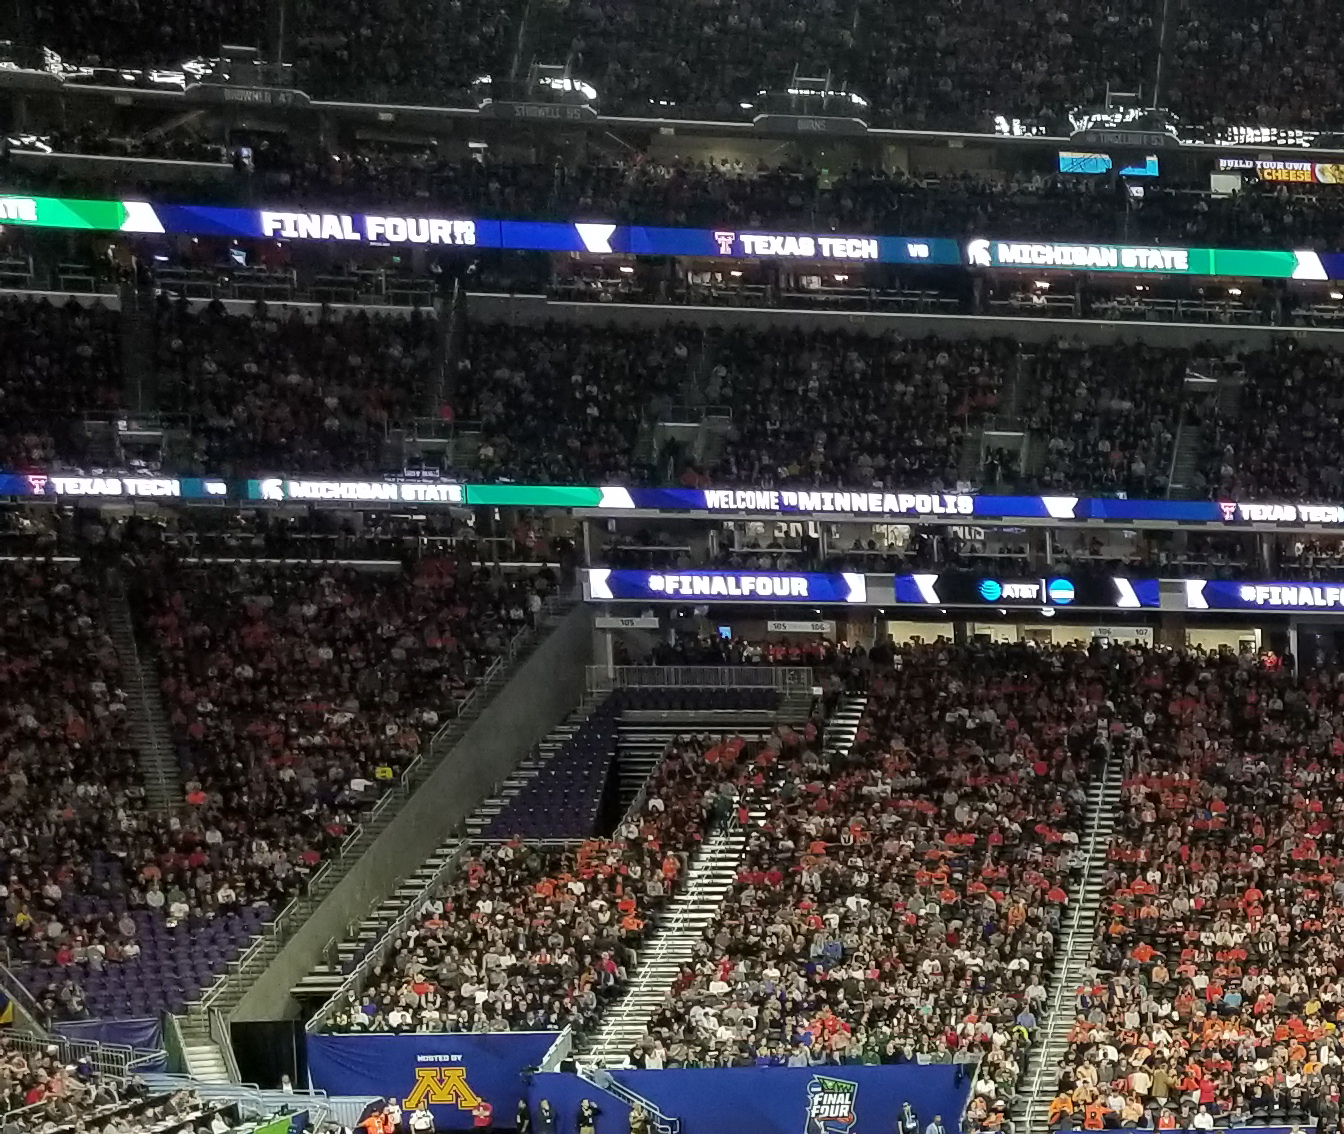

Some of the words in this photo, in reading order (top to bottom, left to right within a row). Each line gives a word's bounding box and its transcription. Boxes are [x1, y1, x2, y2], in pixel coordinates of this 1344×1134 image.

[1263, 170, 1312, 181] CHEESE
[261, 211, 360, 244] FINAL
[365, 216, 450, 246] FOUR
[740, 235, 815, 256] TEXAS
[818, 238, 878, 258] TECH
[998, 243, 1117, 266] MICHIGAN
[51, 478, 121, 494] TEXAS
[123, 479, 179, 496] TECH
[704, 490, 779, 509] WELCOME
[798, 490, 973, 513] MINNEAPOLIS
[1238, 503, 1296, 521] TEXAS
[1298, 505, 1344, 522] TECH
[649, 575, 808, 596] #FINALFOUR
[1002, 584, 1039, 598] AT&T
[416, 1054, 448, 1062] HOSTED
[449, 1054, 463, 1062] BY
[813, 1092, 852, 1106] FINAL
[811, 1105, 850, 1118] FOUR
